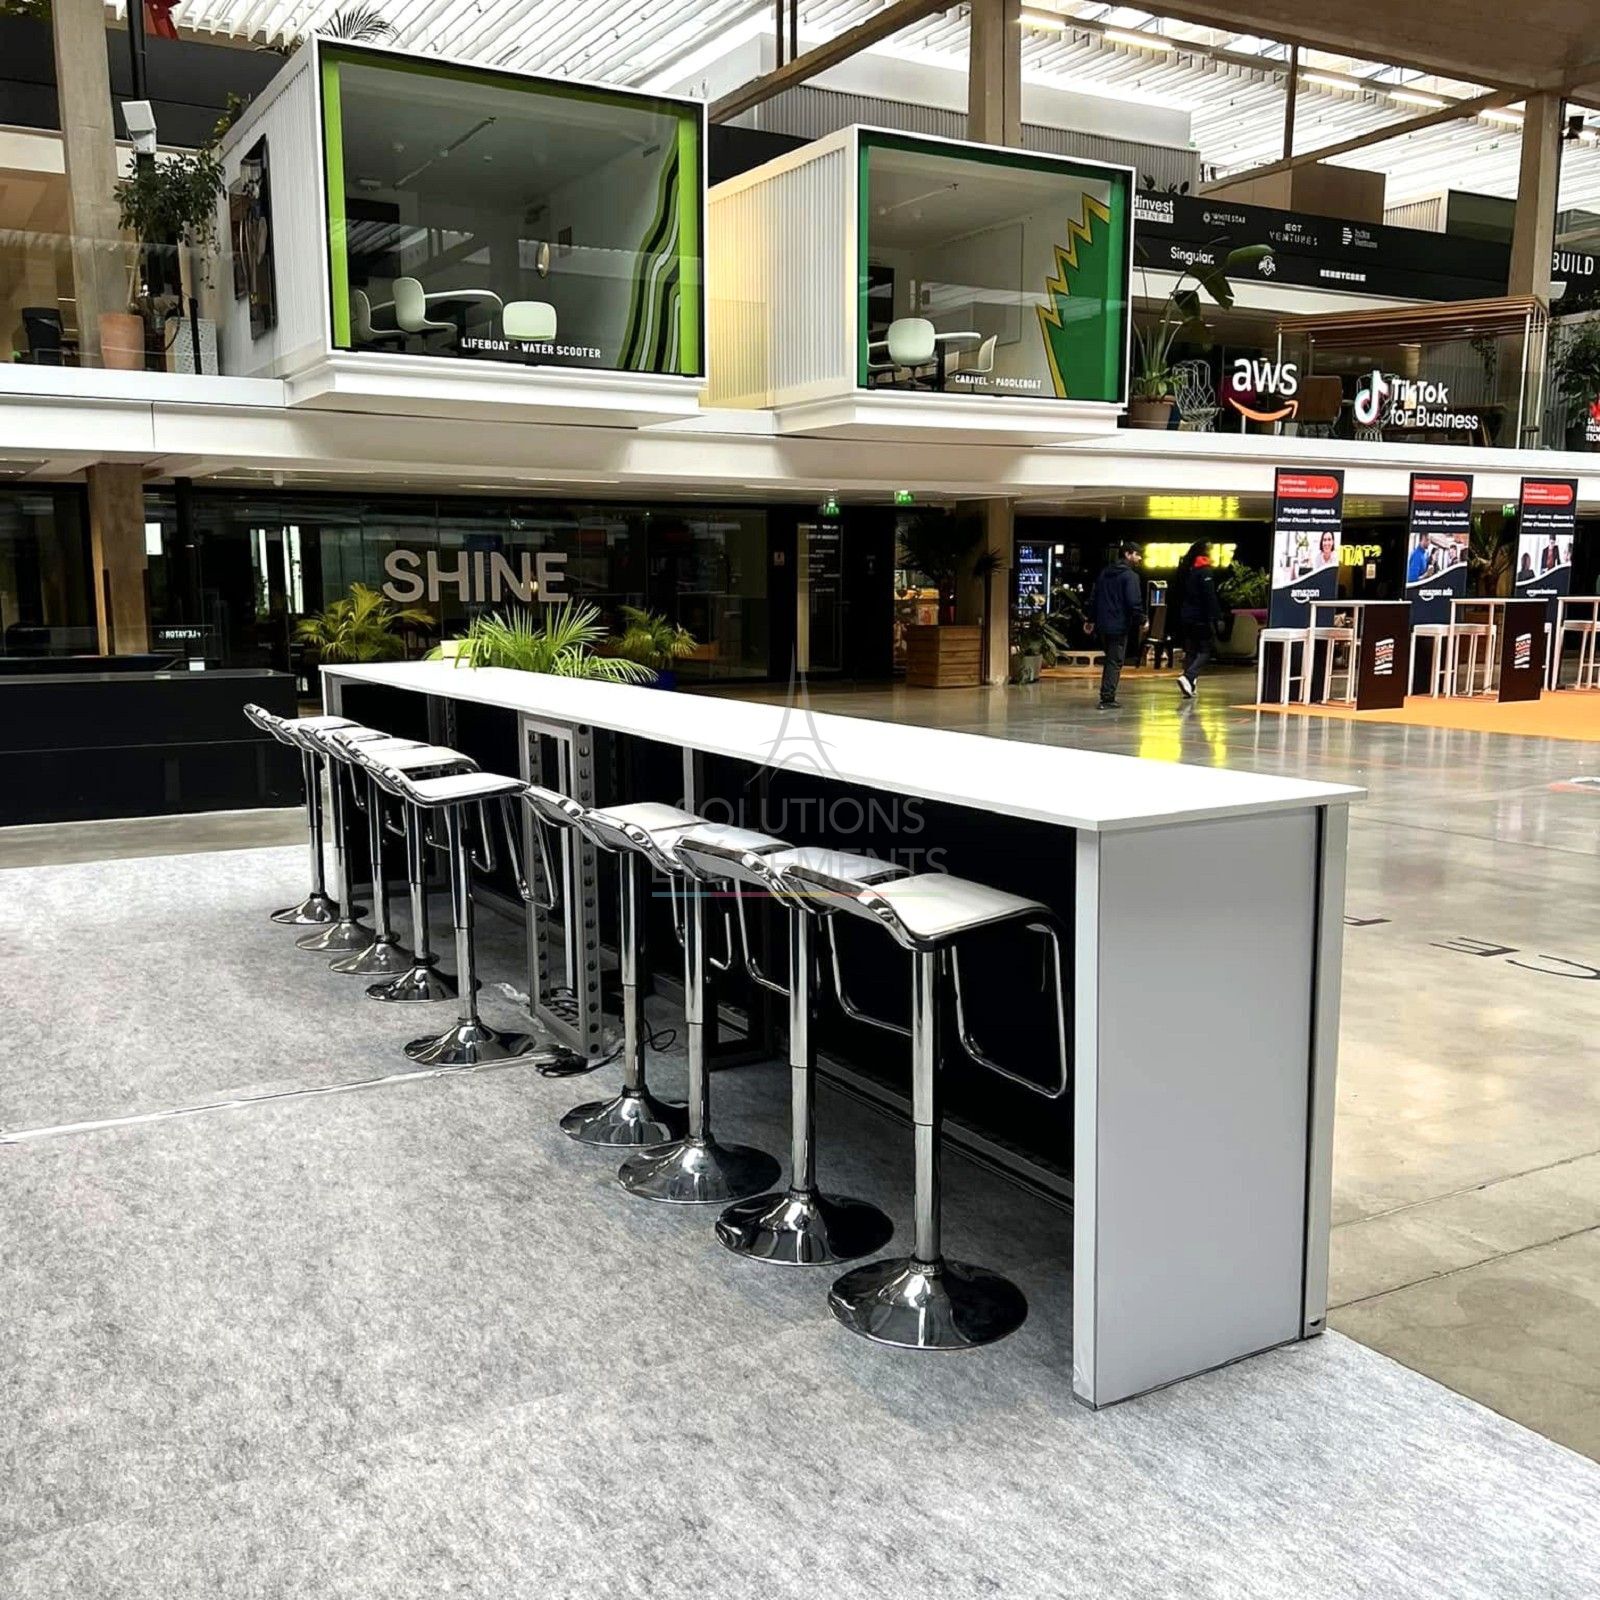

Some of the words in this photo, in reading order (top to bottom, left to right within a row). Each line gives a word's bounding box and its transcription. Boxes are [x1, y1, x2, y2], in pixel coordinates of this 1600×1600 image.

[461, 337, 511, 351] LIFEBOAT
[521, 342, 554, 355] WATER
[556, 346, 601, 359] SCOOTER
[955, 374, 989, 386] CARAVEL
[1232, 357, 1297, 395] aws
[1391, 379, 1449, 404] TikTok
[1390, 405, 1416, 426] for
[1416, 406, 1479, 430] Business
[382, 549, 569, 602] SHINE
